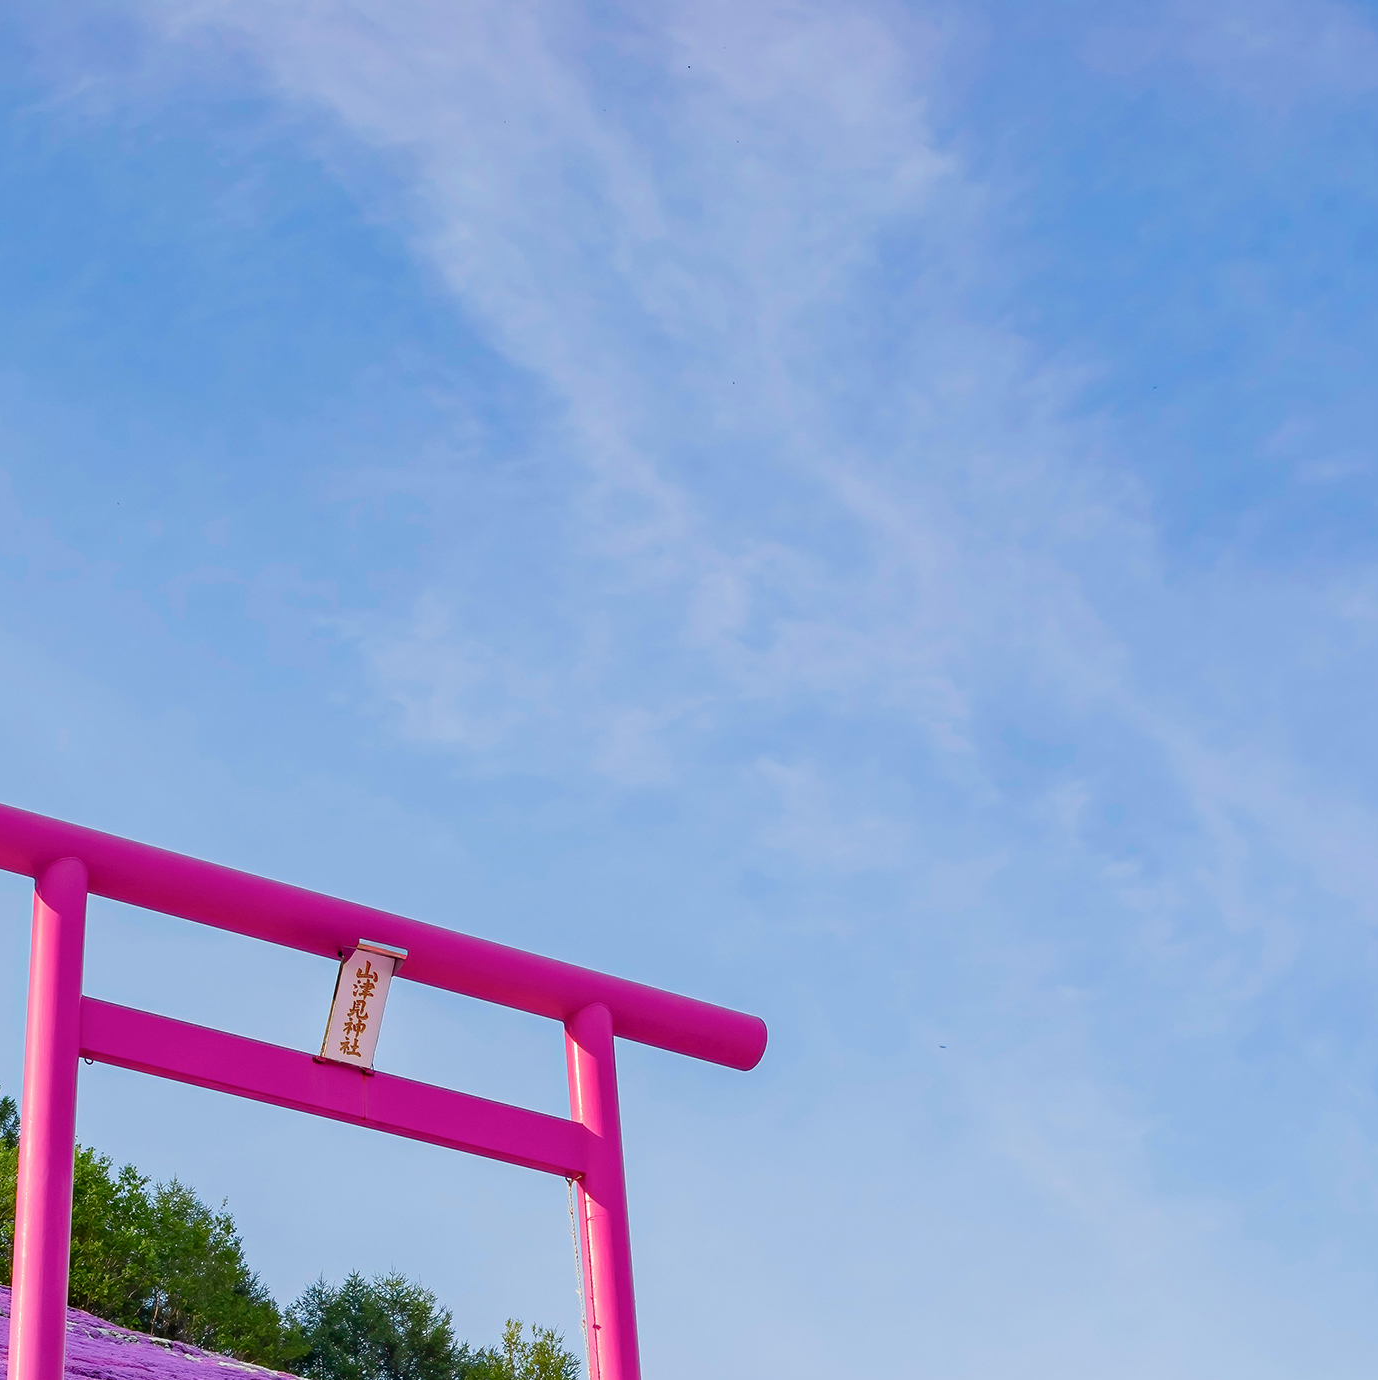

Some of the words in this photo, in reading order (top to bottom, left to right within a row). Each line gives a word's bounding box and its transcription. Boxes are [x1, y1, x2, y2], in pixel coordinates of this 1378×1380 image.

[339, 960, 379, 1058] 山津見神社
